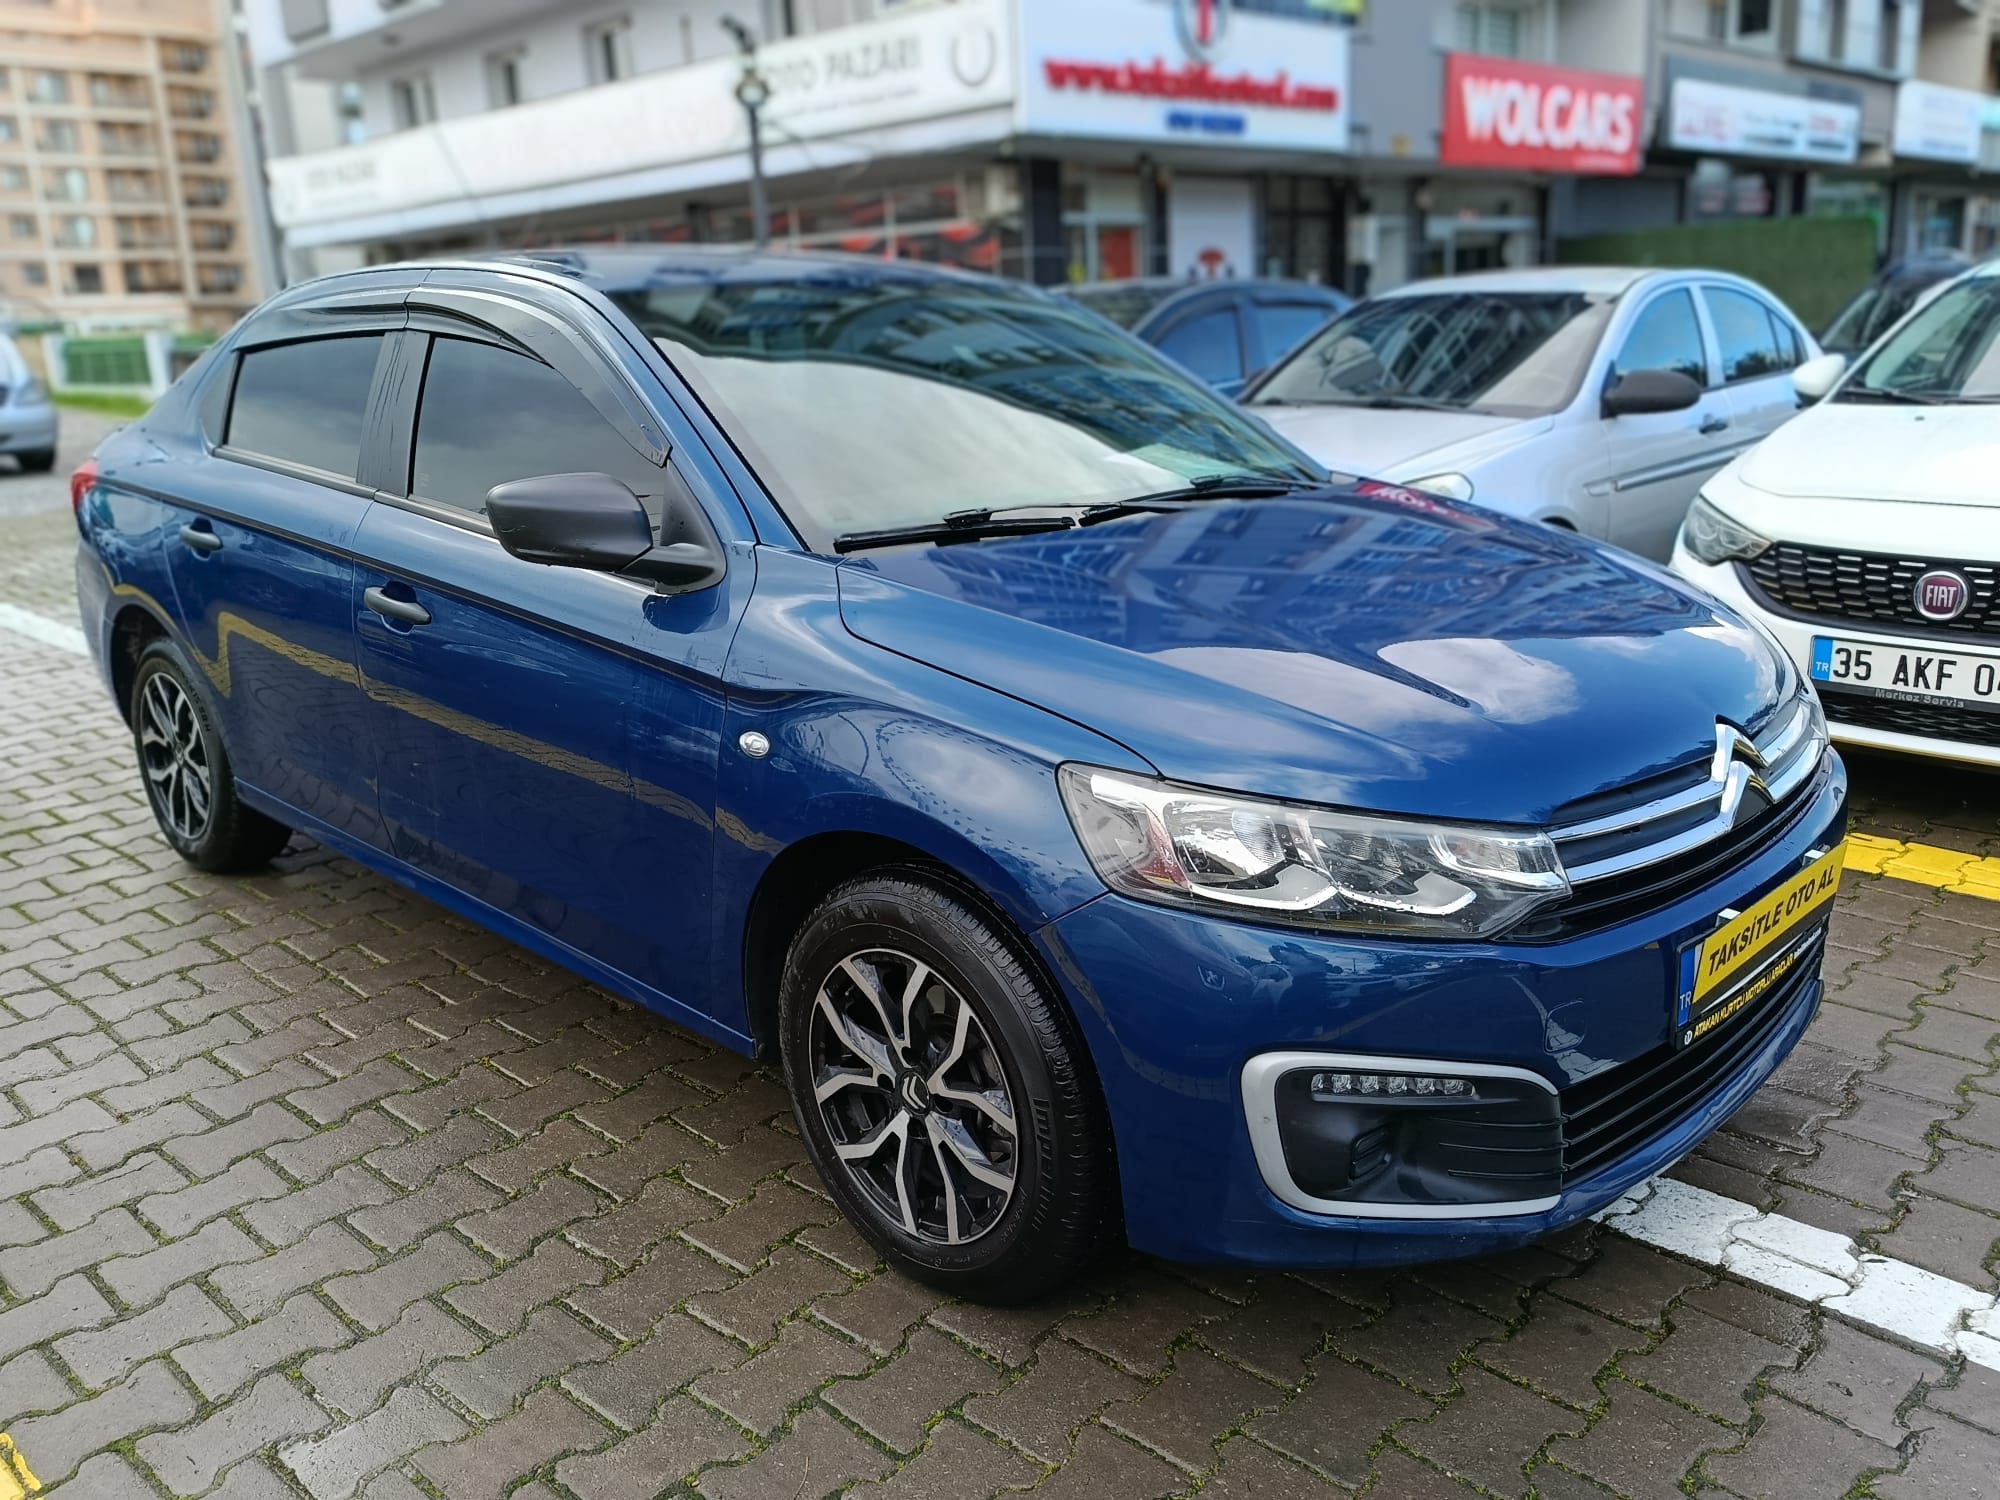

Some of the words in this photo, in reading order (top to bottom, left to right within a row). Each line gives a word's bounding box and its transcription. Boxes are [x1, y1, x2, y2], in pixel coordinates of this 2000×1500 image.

[1462, 75, 1634, 155] WOLCARS
[1925, 584, 1958, 609] FIAT
[1815, 660, 1829, 673] TR
[1832, 647, 1873, 682] 35
[1891, 654, 1958, 691] AKF
[1973, 663, 2000, 697] 0
[1709, 900, 1784, 977] TAKSİTLE
[1785, 878, 1816, 917] OTO
[1816, 864, 1835, 895] AL
[1679, 990, 1692, 1012] TR
